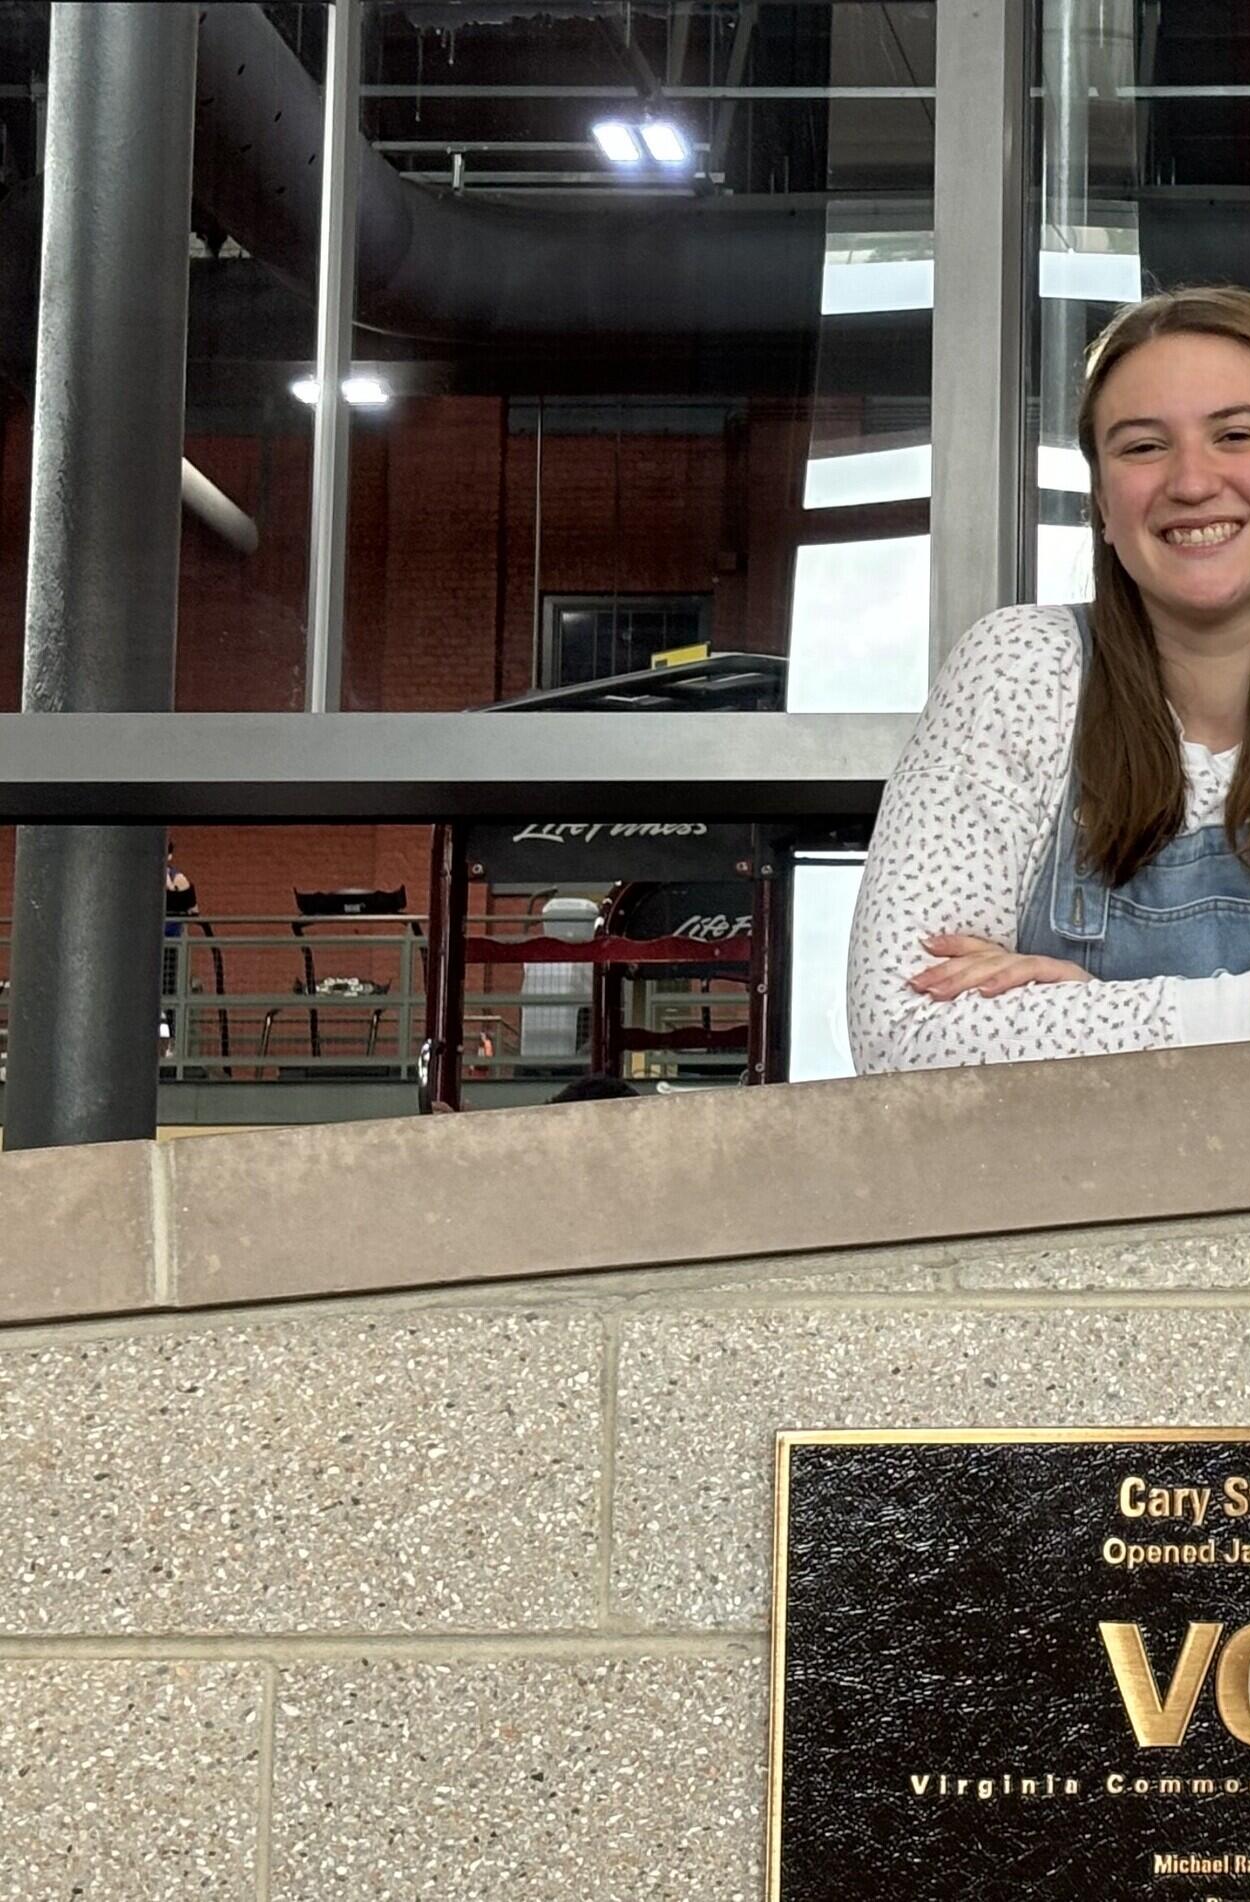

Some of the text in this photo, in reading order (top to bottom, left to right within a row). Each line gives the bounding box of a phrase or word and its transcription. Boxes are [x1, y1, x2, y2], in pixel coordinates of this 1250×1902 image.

[726, 914, 752, 940] F
[1120, 1476, 1210, 1525] Cary
[1102, 1538, 1216, 1569] Opened
[910, 1774, 1078, 1799] Virginia
[1153, 1854, 1228, 1874] Michael
